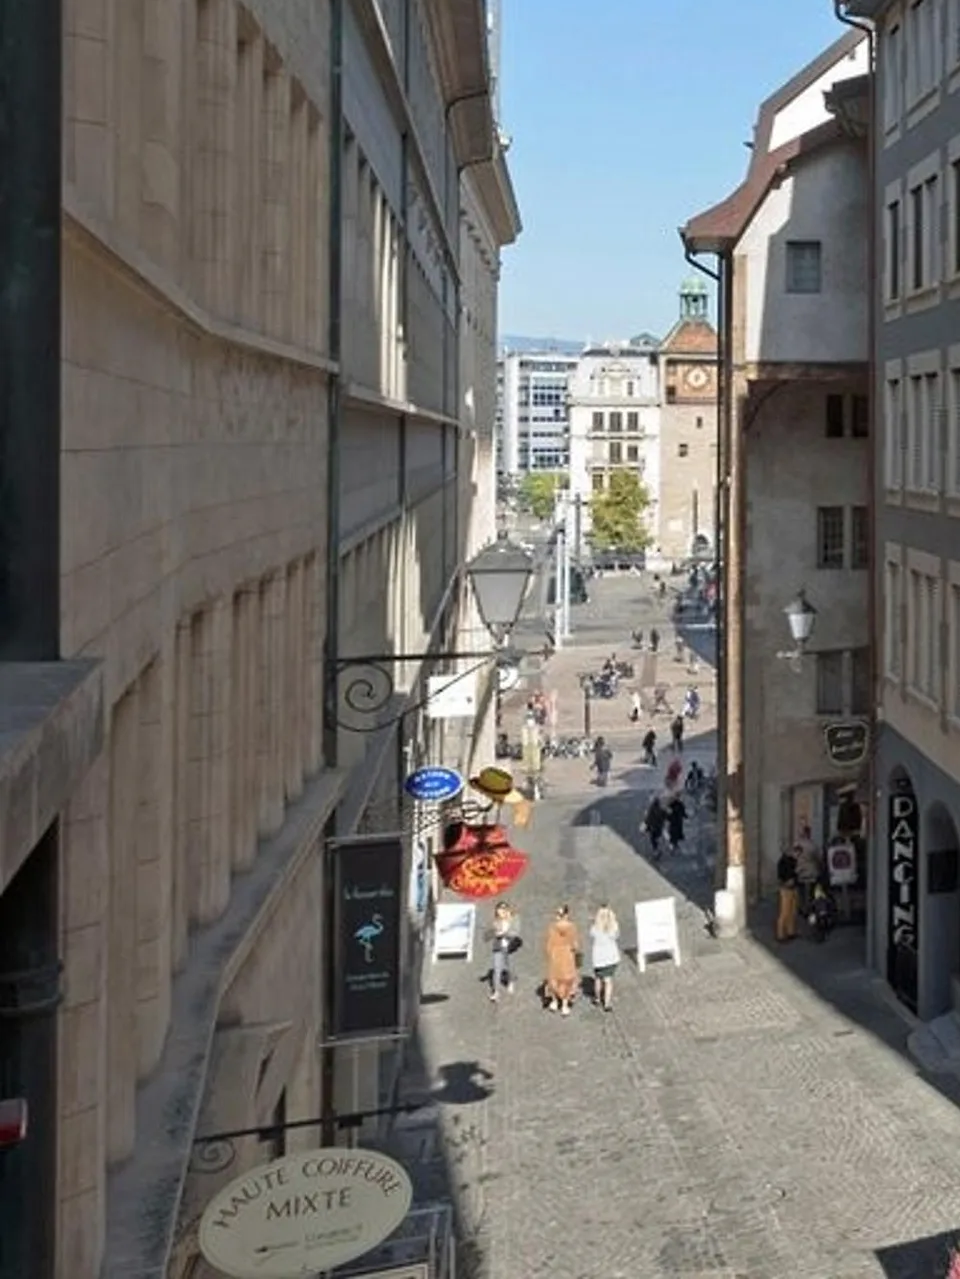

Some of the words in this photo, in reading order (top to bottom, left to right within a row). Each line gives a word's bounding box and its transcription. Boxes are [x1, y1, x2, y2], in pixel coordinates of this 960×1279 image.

[891, 796, 917, 949] DANCING
[212, 1167, 289, 1228] HAUTE
[302, 1158, 400, 1198] COIFFURE
[266, 1187, 352, 1220] MIXTE
